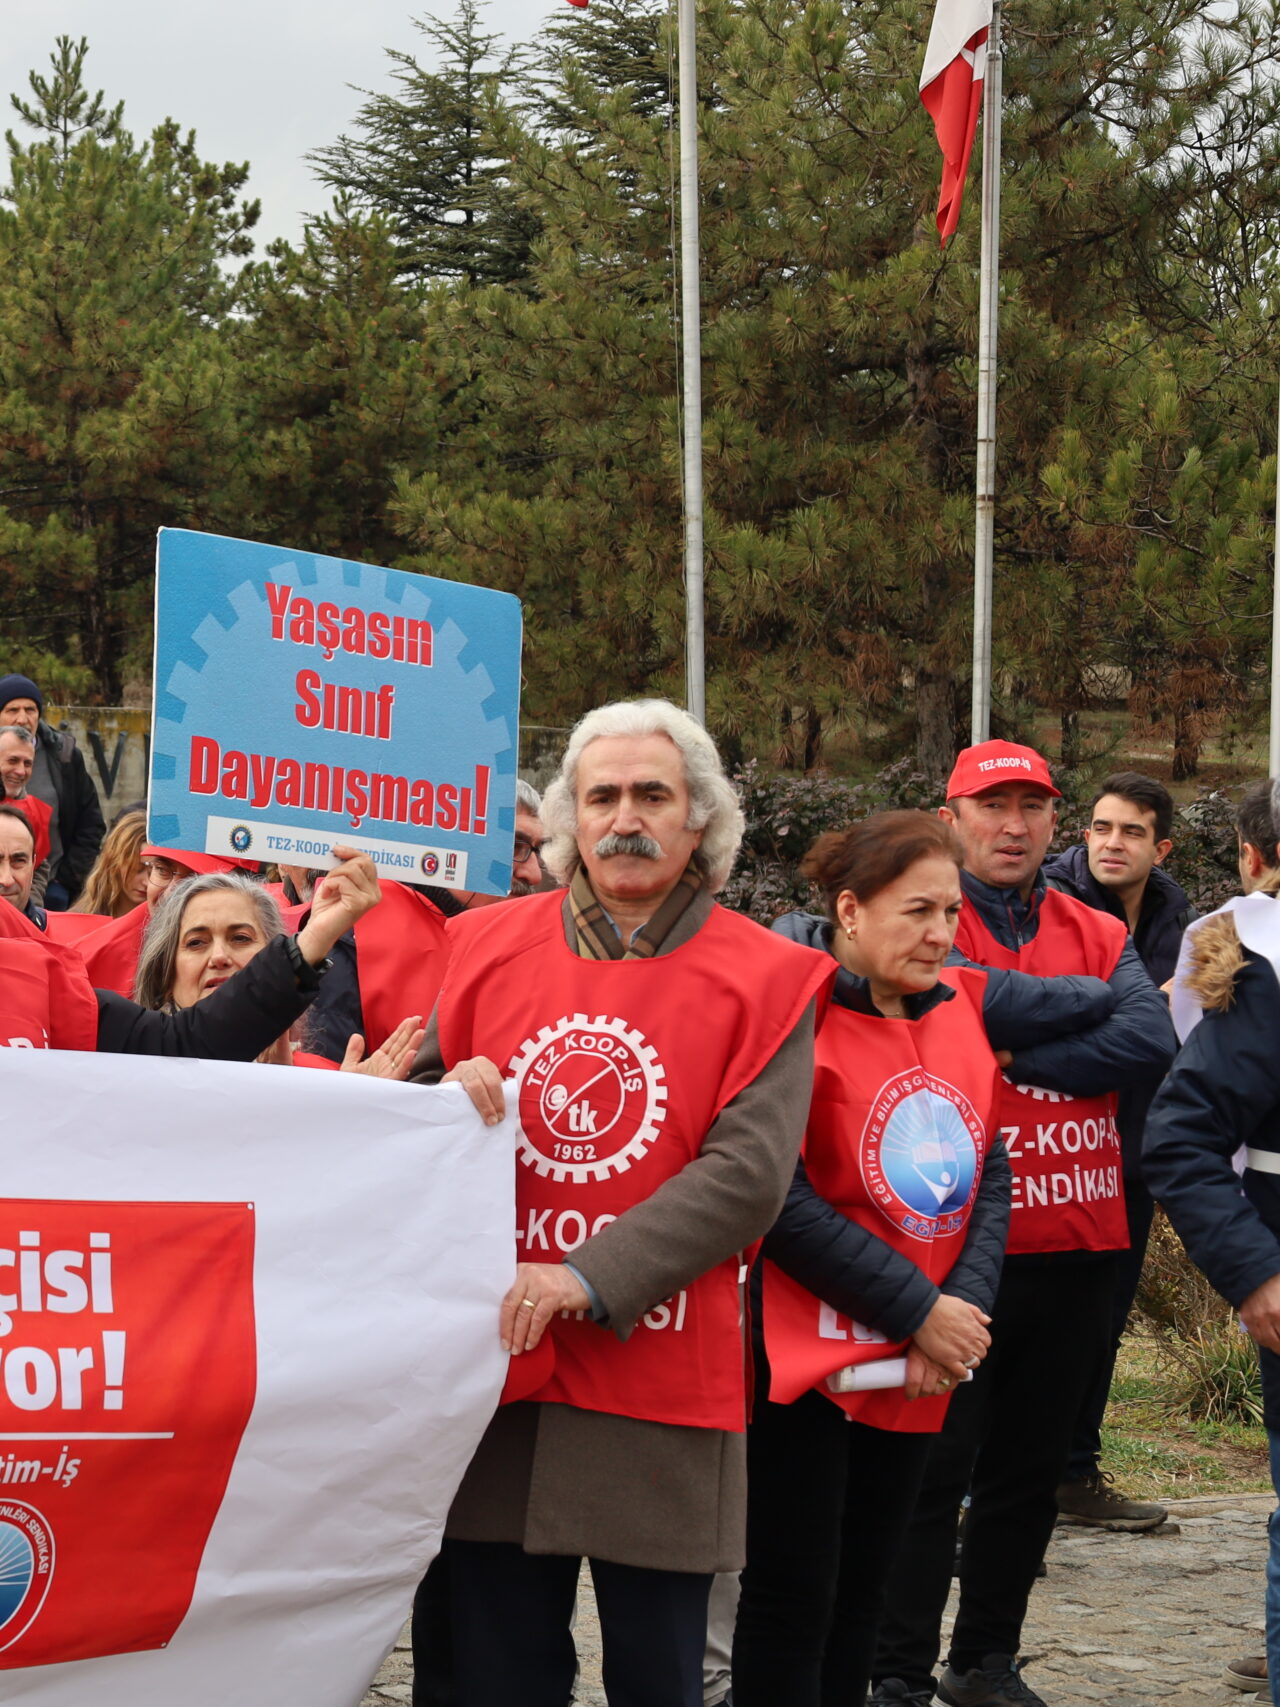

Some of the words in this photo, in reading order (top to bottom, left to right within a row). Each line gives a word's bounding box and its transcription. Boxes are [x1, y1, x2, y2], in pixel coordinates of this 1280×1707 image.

[264, 581, 434, 667] Yaşasın
[294, 668, 395, 741] Sınıf
[188, 734, 491, 837] Dayanışması!
[978, 757, 1032, 773] TEZ-KOOP-İŞ
[526, 1045, 561, 1088] TEZ
[568, 1100, 598, 1132] tk
[868, 1123, 881, 1143] VE
[877, 1087, 900, 1123] BİLİM
[1000, 1109, 1120, 1158] Z-KOOP-İŞ
[553, 1143, 597, 1161] 1962
[1010, 1164, 1119, 1209] ENDİKASI
